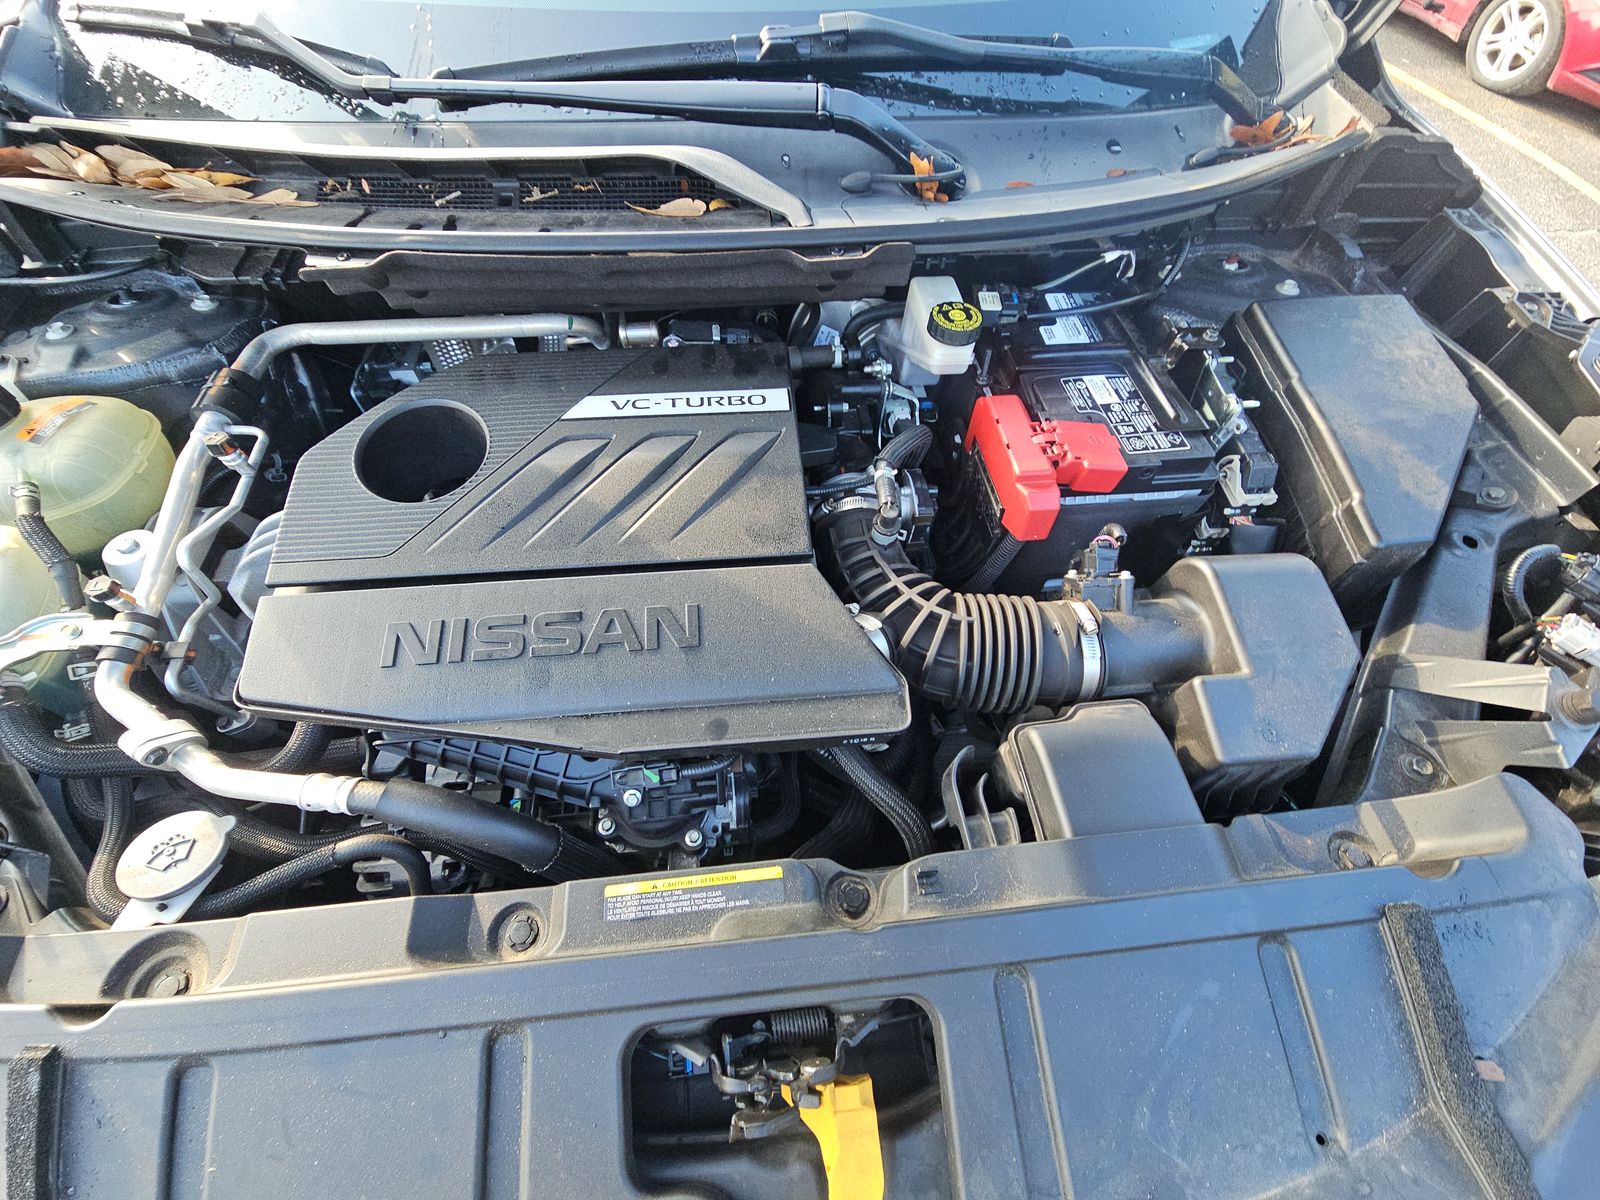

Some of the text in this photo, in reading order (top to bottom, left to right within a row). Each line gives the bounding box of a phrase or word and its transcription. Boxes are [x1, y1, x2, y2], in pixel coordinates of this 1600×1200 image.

[611, 394, 767, 410] VC-TURBO
[380, 603, 700, 668] NISSAN
[662, 880, 693, 888] CAUTION
[700, 875, 737, 884] ATTENTION
